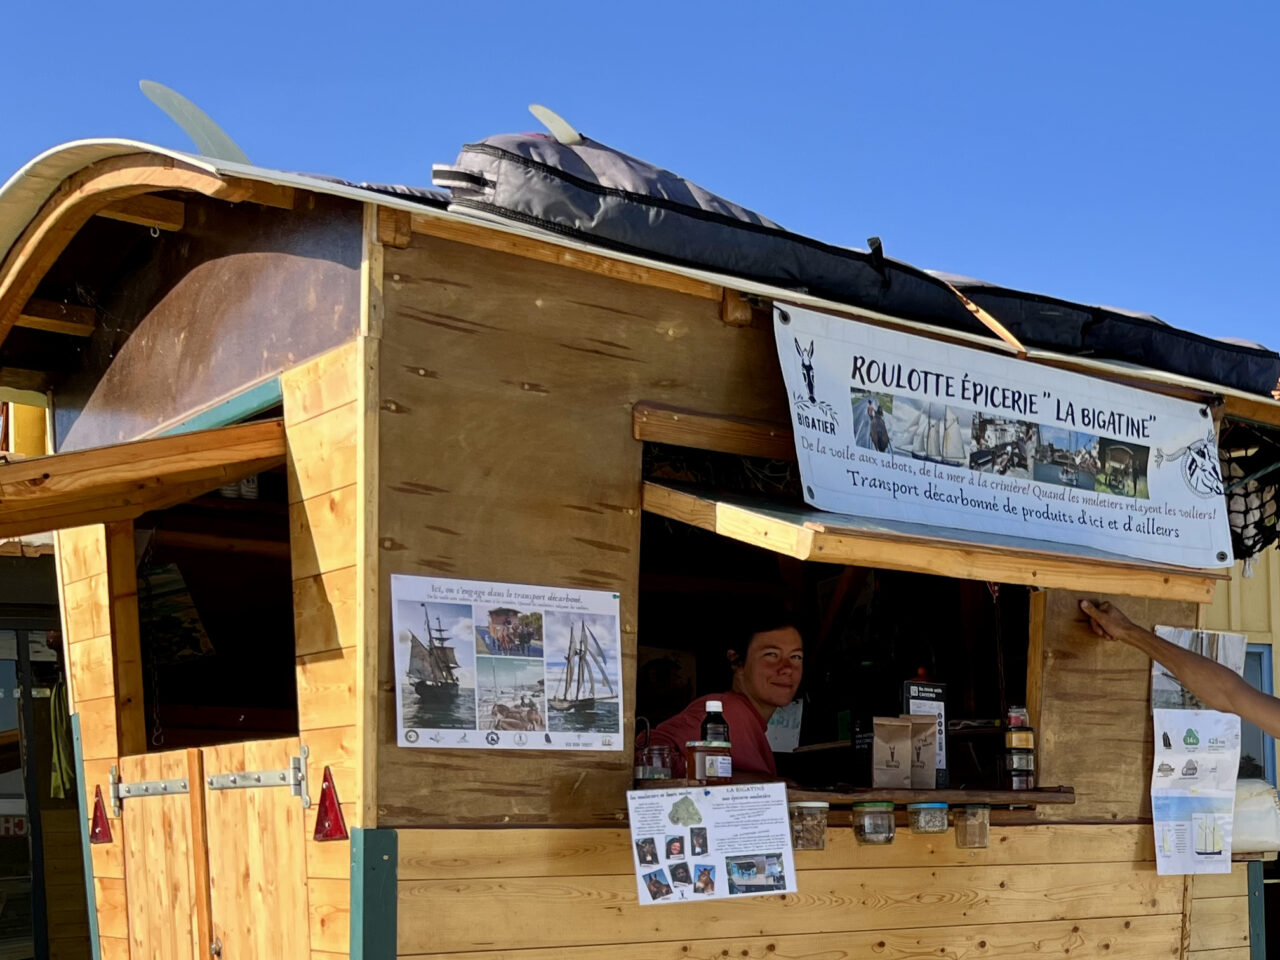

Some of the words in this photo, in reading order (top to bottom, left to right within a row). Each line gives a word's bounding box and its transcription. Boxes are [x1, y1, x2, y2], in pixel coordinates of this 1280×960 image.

[797, 412, 836, 436] BIGATIER
[851, 355, 955, 397] ROULOTTE
[961, 373, 1039, 415] ÉPICERIE
[1081, 408, 1156, 439] BIGATINE"
[801, 436, 814, 451] De
[816, 438, 826, 455] la
[829, 445, 856, 461] voile
[858, 454, 878, 465] aux
[881, 456, 917, 477] sabots,
[919, 461, 931, 477] de
[933, 464, 944, 480] la
[947, 472, 965, 484] mer
[968, 472, 975, 486] à
[977, 473, 988, 488] la
[1032, 485, 1067, 502] Quand
[1068, 490, 1080, 504] les
[1082, 493, 1124, 511] muletiers
[1126, 498, 1163, 518] relayent
[1164, 502, 1177, 517] les
[1179, 506, 1216, 520] voiliers!
[847, 469, 919, 500] Transport
[1003, 497, 1018, 515] de
[1022, 504, 1074, 525] produits
[1078, 510, 1104, 529] d'ici
[1108, 520, 1119, 531] et
[1123, 515, 1180, 538] d'ailleurs
[506, 589, 513, 598] le
[514, 592, 546, 603] transport
